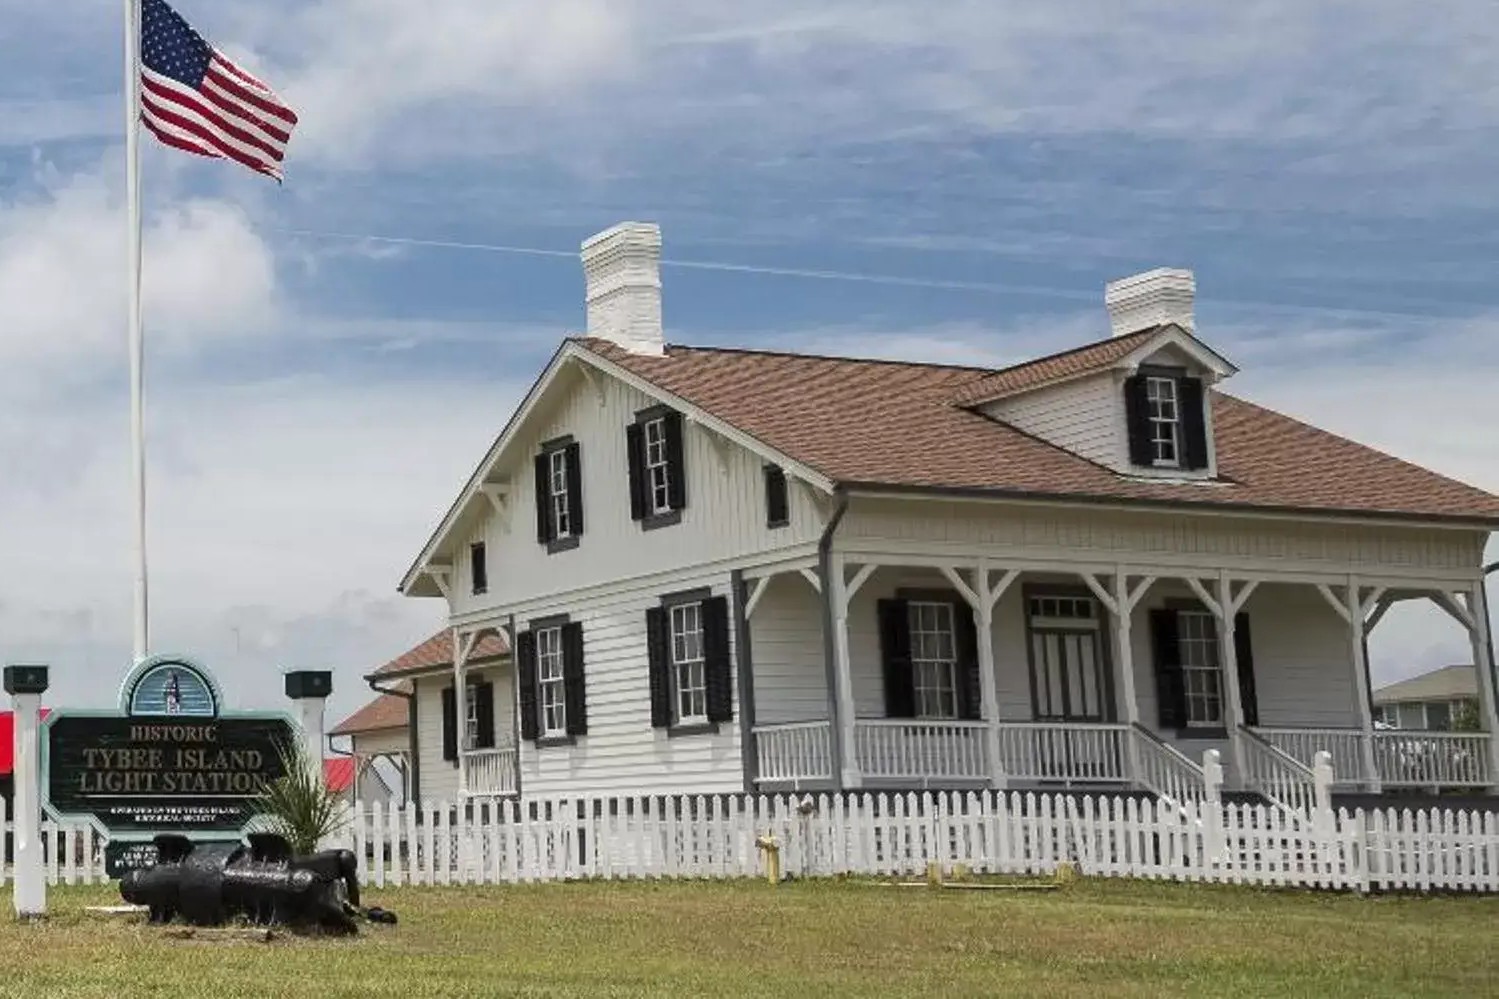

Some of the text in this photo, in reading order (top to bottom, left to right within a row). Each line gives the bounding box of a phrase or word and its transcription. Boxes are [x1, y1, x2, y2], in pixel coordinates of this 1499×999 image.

[130, 725, 216, 742] HISTORIC
[82, 748, 262, 770] TYBEE ISLAND
[80, 771, 269, 792] LIGHT STATION
